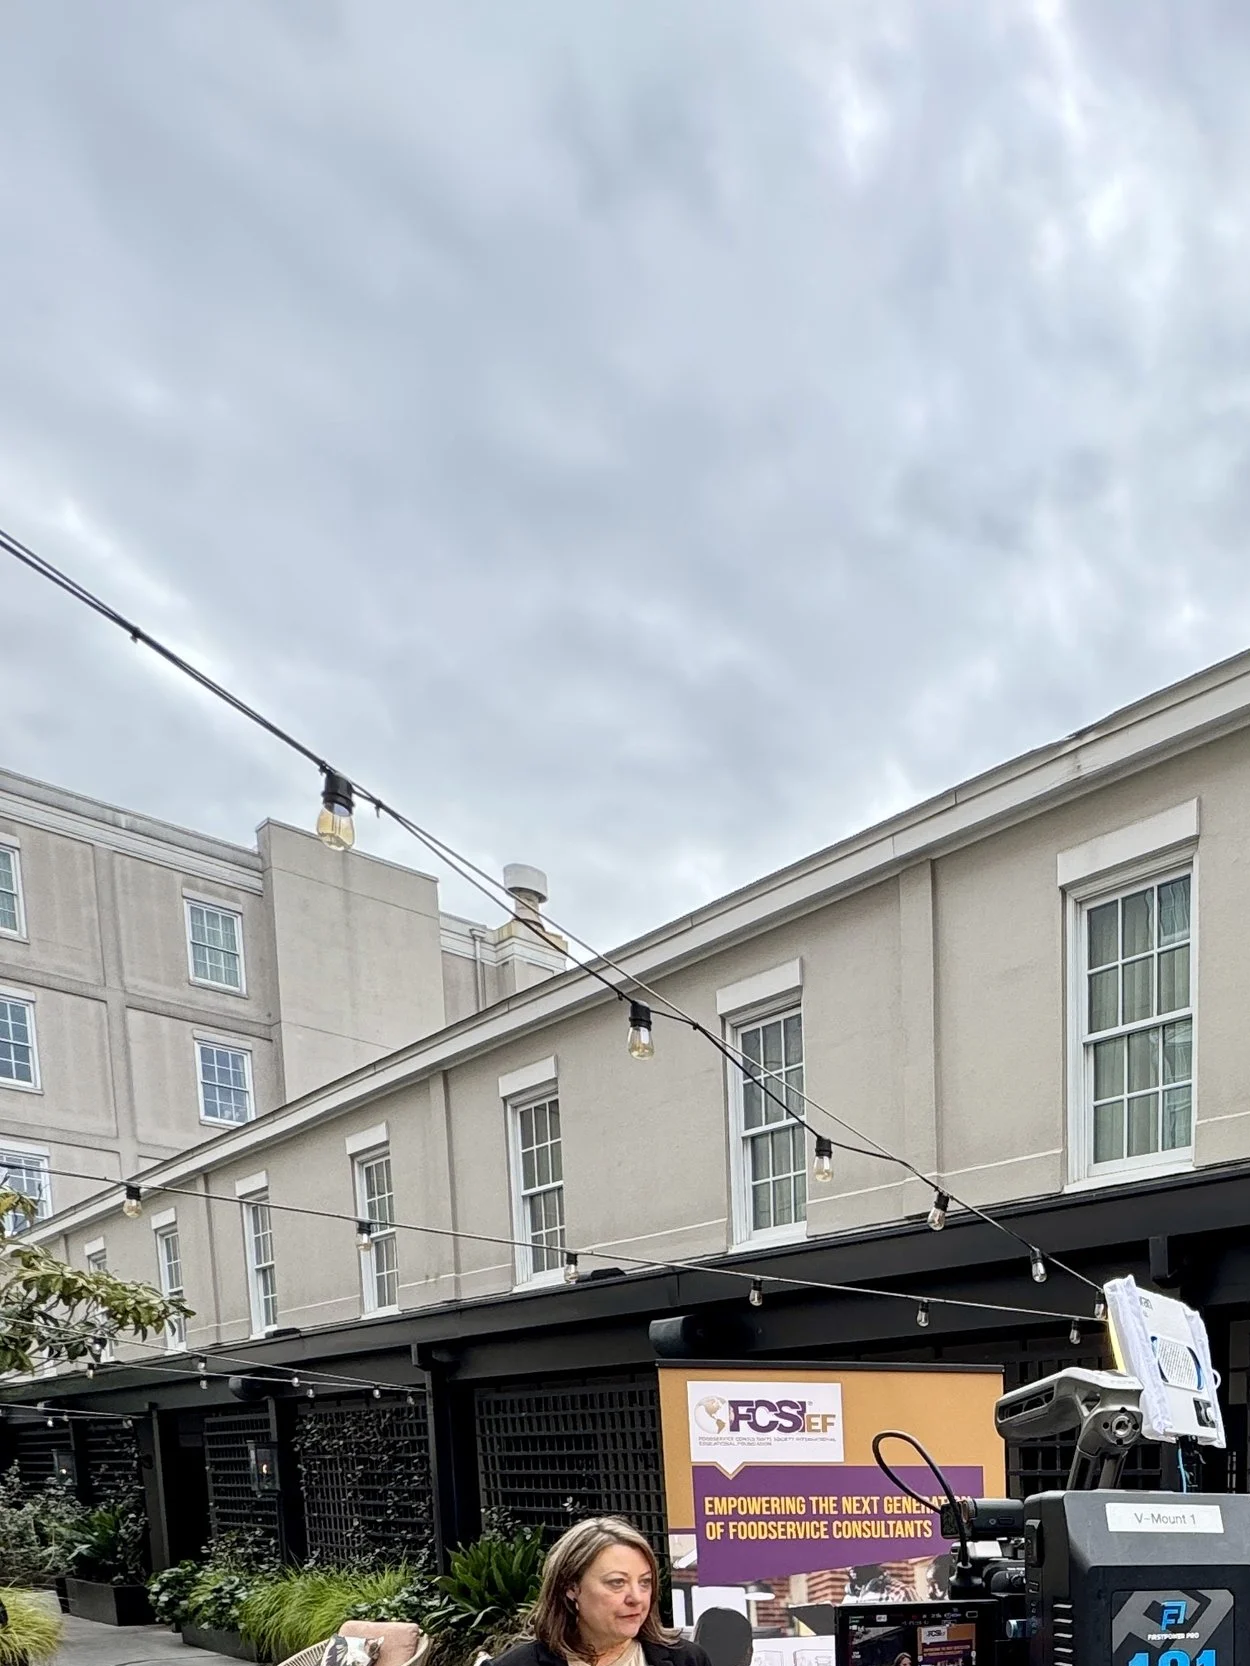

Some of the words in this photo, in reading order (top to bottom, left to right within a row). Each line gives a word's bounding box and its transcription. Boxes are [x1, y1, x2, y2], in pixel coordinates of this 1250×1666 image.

[728, 1399, 807, 1433] FCSI
[806, 1414, 836, 1433] EF
[704, 1496, 806, 1516] EMPOWERING
[809, 1496, 838, 1515] THE
[842, 1496, 880, 1515] NEXT
[1134, 1512, 1187, 1525] V-Mount
[1190, 1513, 1196, 1525] 1
[706, 1521, 725, 1541] OF
[729, 1520, 829, 1540] FOODSERVICE
[832, 1519, 932, 1539] CONSULTANTS
